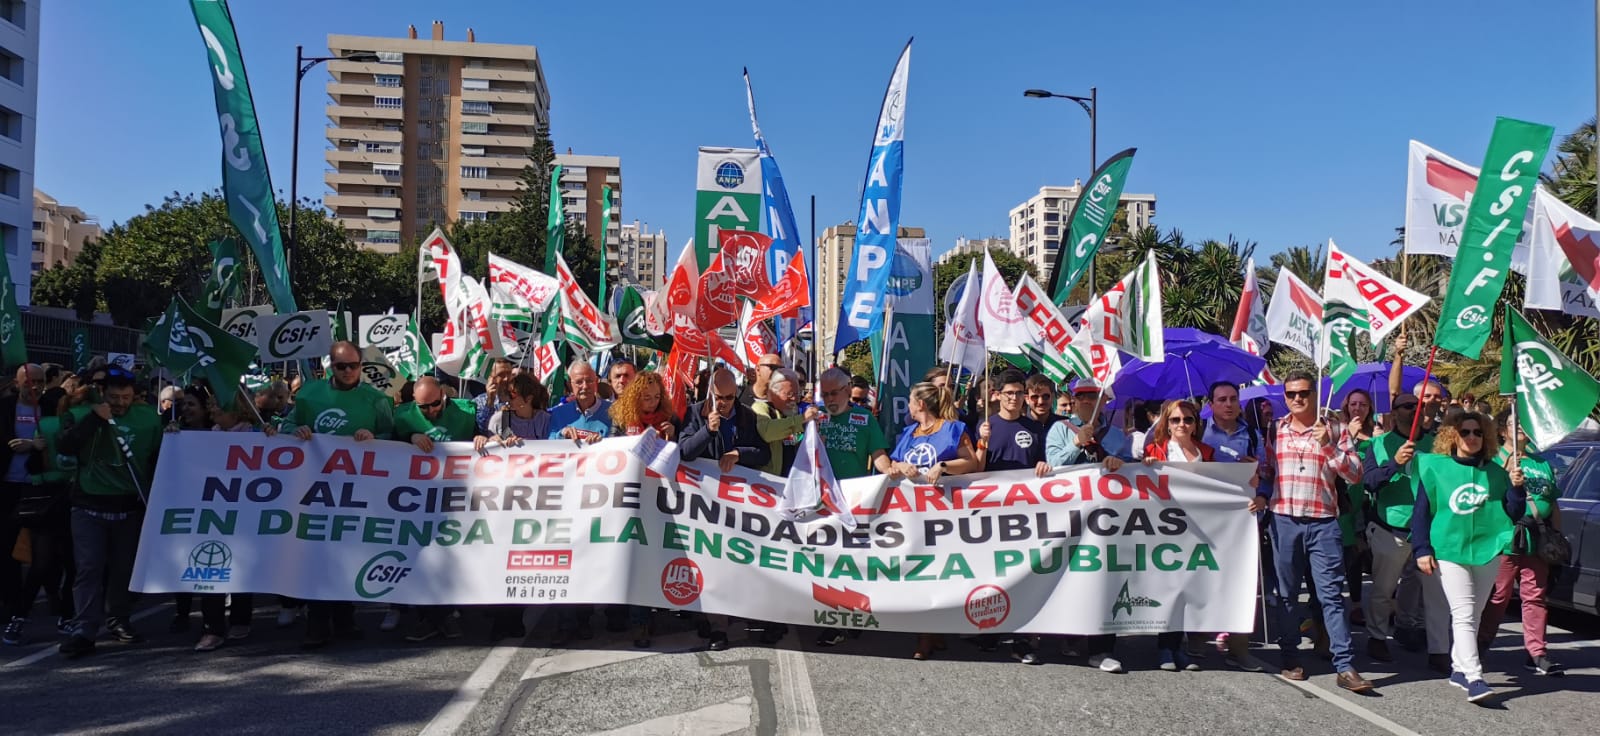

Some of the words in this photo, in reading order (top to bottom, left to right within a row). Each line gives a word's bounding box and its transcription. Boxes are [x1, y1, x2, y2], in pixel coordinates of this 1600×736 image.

[848, 151, 890, 329] ANPE
[226, 445, 305, 471] NO
[321, 448, 389, 477] AL
[409, 450, 628, 481] DECRETO
[717, 474, 1171, 516] ESLARIZACION
[201, 476, 283, 502] NO
[299, 481, 368, 508] AL
[387, 485, 564, 513] CIERRE
[580, 482, 641, 510] DE
[656, 486, 905, 549] UNIDADES
[924, 507, 1188, 547] PÚBLICAS
[160, 508, 239, 535] EN
[258, 508, 494, 547] DEFENSA
[511, 517, 573, 545] DE
[589, 516, 648, 545] LA
[662, 521, 975, 582] ENSEÑANZA
[994, 541, 1219, 577] PÚBLICA
[511, 554, 555, 567] CCOO
[181, 567, 232, 580] ANPE
[367, 564, 412, 584] CSIF
[505, 573, 570, 585] enseñanza
[669, 563, 700, 581] UGT
[506, 586, 568, 600] Málaga
[970, 593, 1003, 610] FRENTE
[814, 609, 880, 628] USTEA
[970, 605, 1006, 618] ESTUDIANTES
